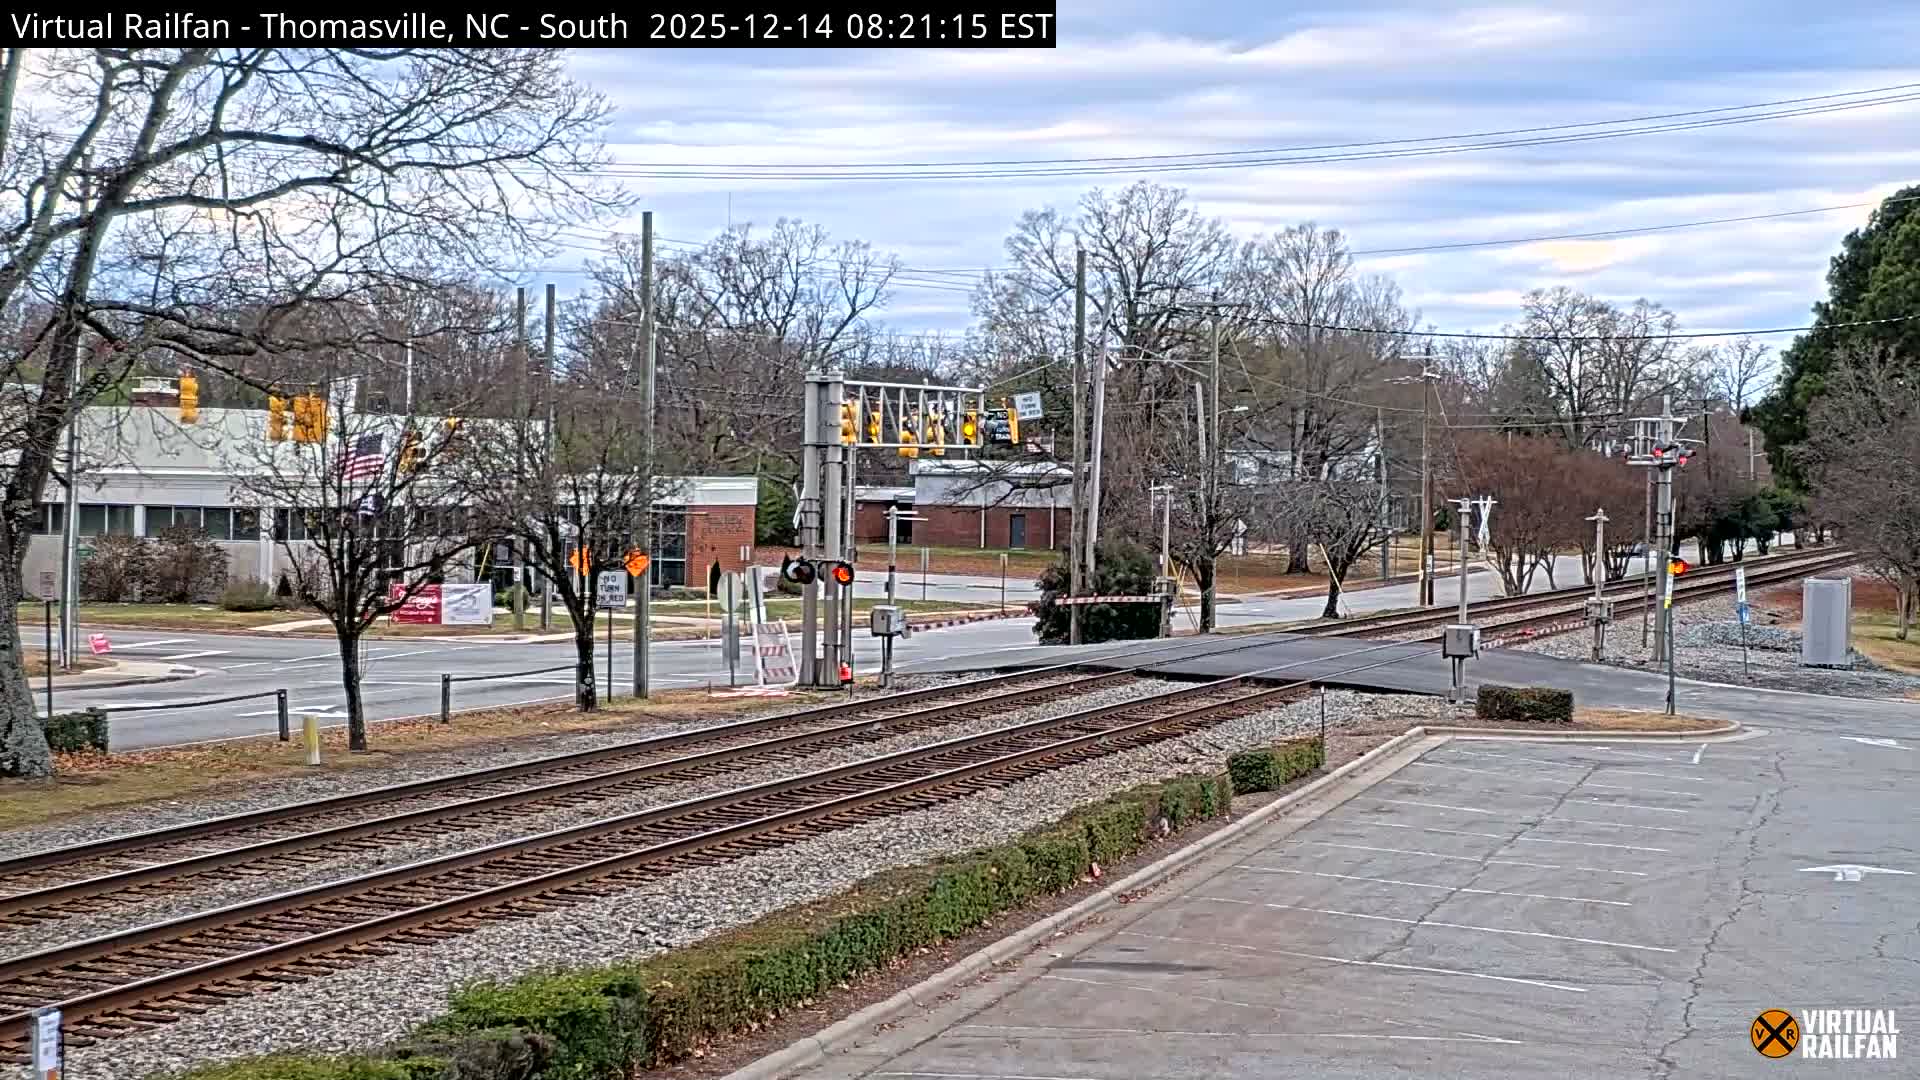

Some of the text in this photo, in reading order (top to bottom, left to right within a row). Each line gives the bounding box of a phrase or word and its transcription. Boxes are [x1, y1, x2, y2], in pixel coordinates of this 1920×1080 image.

[604, 575, 616, 583] NO
[600, 584, 620, 592] TURN
[609, 594, 624, 602] RED
